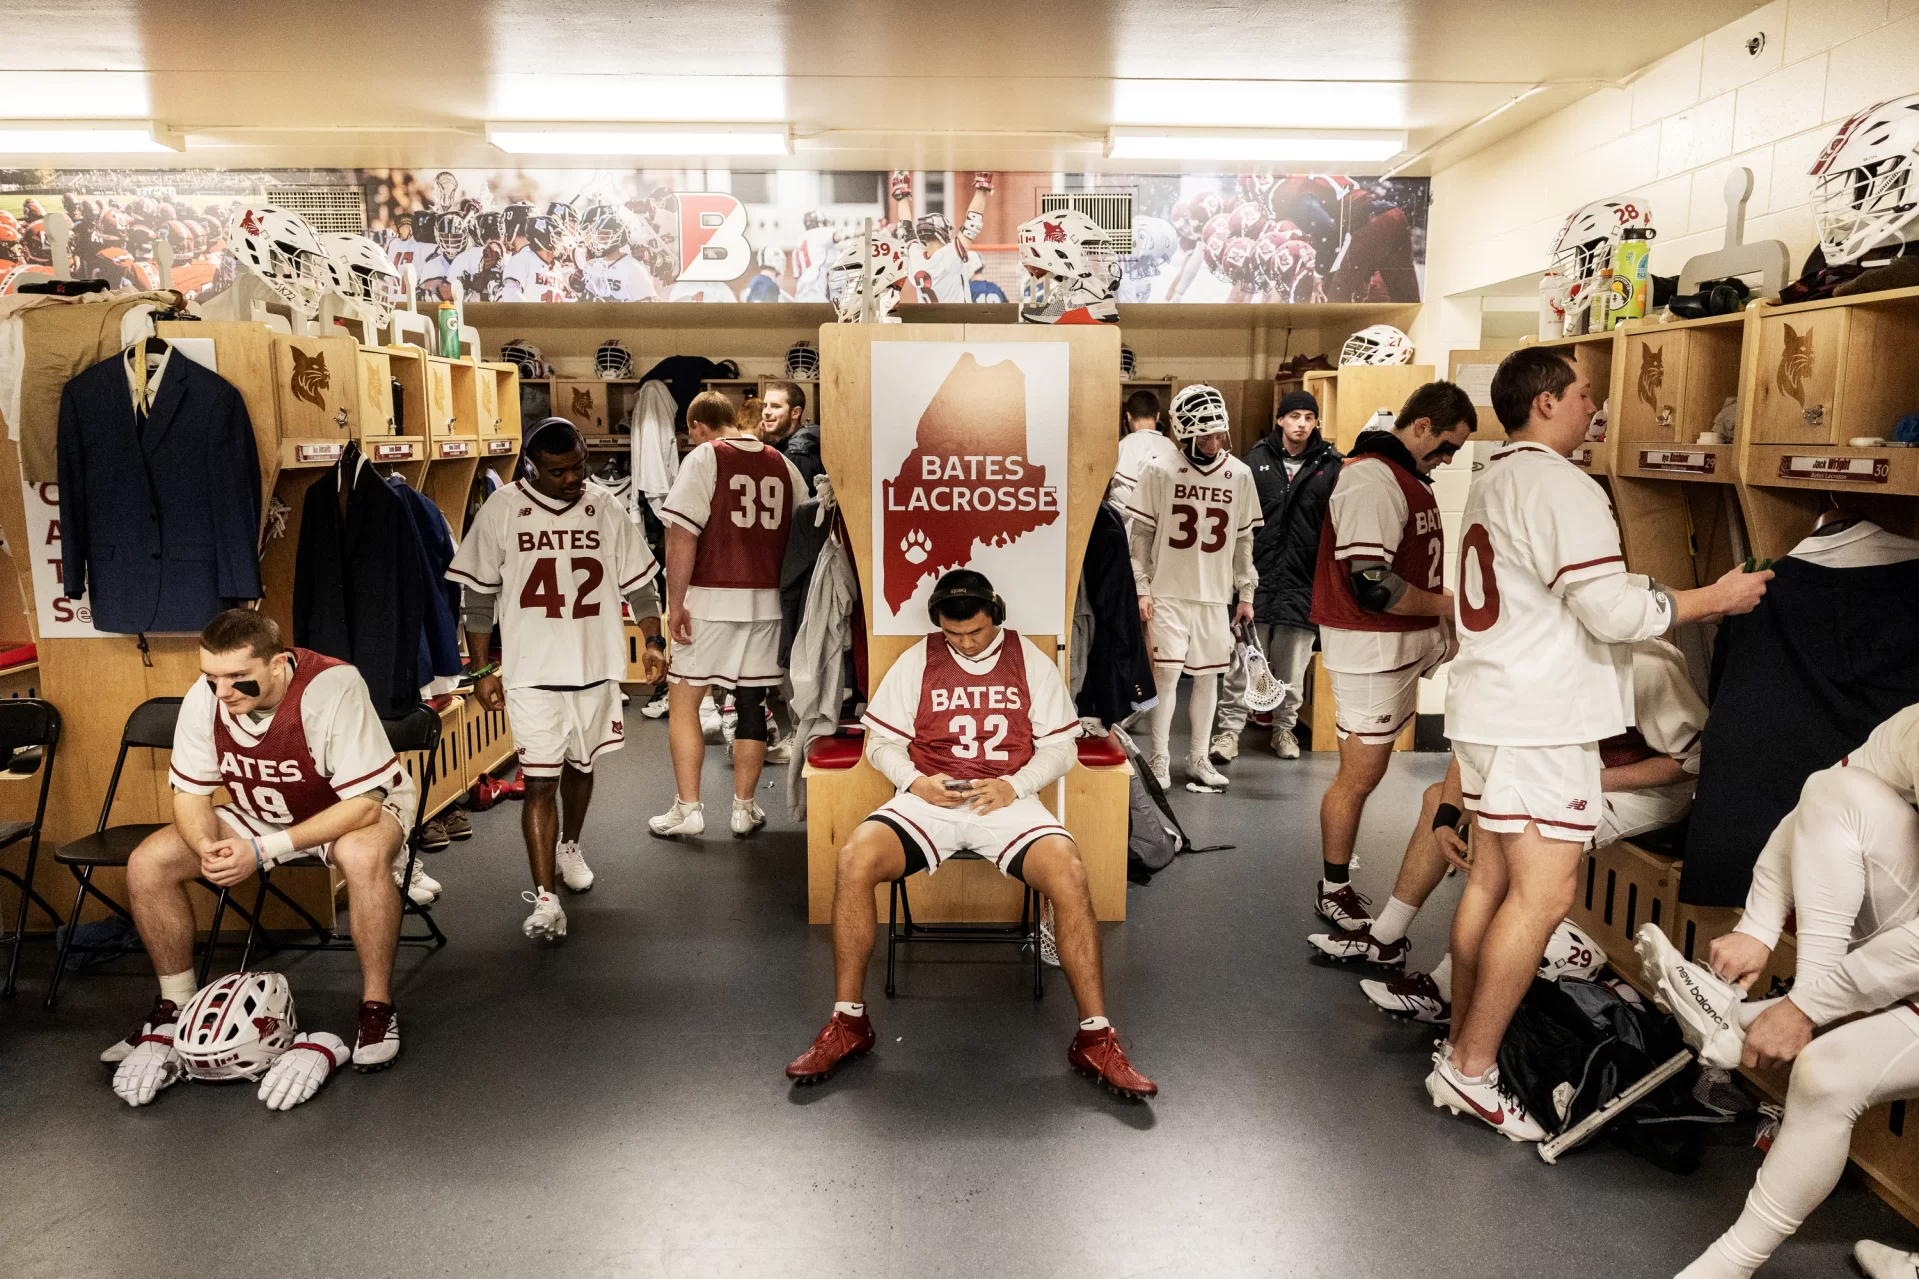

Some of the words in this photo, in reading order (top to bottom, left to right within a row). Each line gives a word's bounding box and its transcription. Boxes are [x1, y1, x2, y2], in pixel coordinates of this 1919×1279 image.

[1613, 204, 1639, 225] 28
[1389, 337, 1402, 347] 21
[921, 455, 1024, 480] BATES
[1705, 458, 1715, 468] 29
[1813, 459, 1827, 469] Jack
[1827, 458, 1851, 471] Wright
[1874, 464, 1889, 477] 30
[729, 474, 784, 530] 39
[888, 486, 1057, 511] LACROSSE
[1174, 484, 1233, 504] BATES
[517, 530, 600, 552] BATES
[1168, 504, 1229, 553] 33
[1428, 537, 1441, 588] 2
[520, 556, 604, 619] 42
[1459, 523, 1500, 632] 0
[931, 686, 1022, 712] BATES
[949, 714, 1009, 761] 32
[220, 752, 303, 782] ATES
[229, 781, 294, 824] 19
[1567, 946, 1592, 968] 29
[1676, 965, 1693, 986] new
[1689, 986, 1729, 1031] balance
